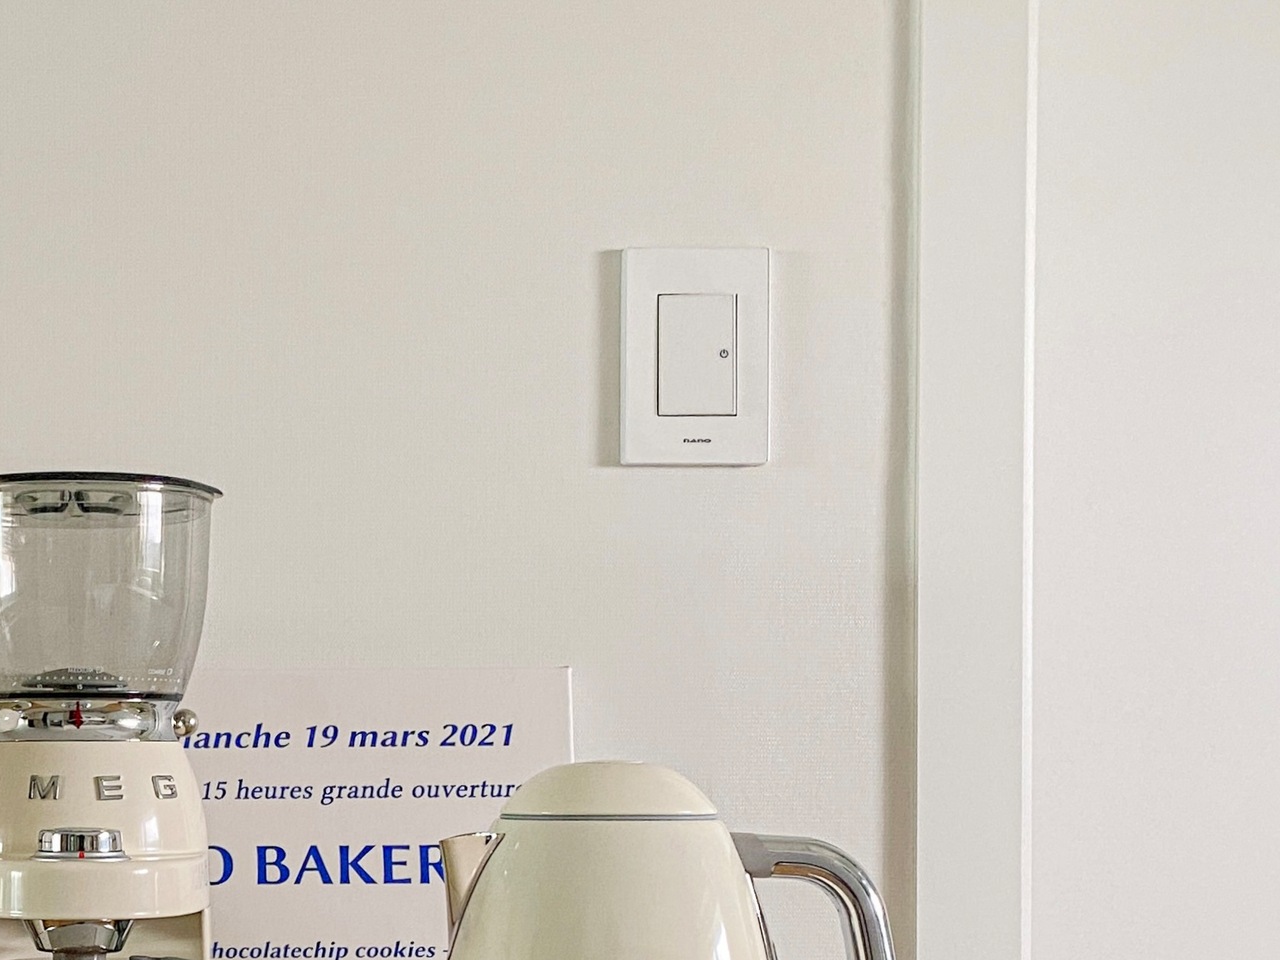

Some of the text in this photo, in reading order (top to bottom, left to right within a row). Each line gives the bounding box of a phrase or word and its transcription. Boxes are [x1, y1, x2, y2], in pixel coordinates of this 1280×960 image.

[184, 723, 513, 749] anche 19 mars 2021
[201, 778, 522, 806] 15 heures grande ouvertur
[355, 940, 436, 958] cookies
